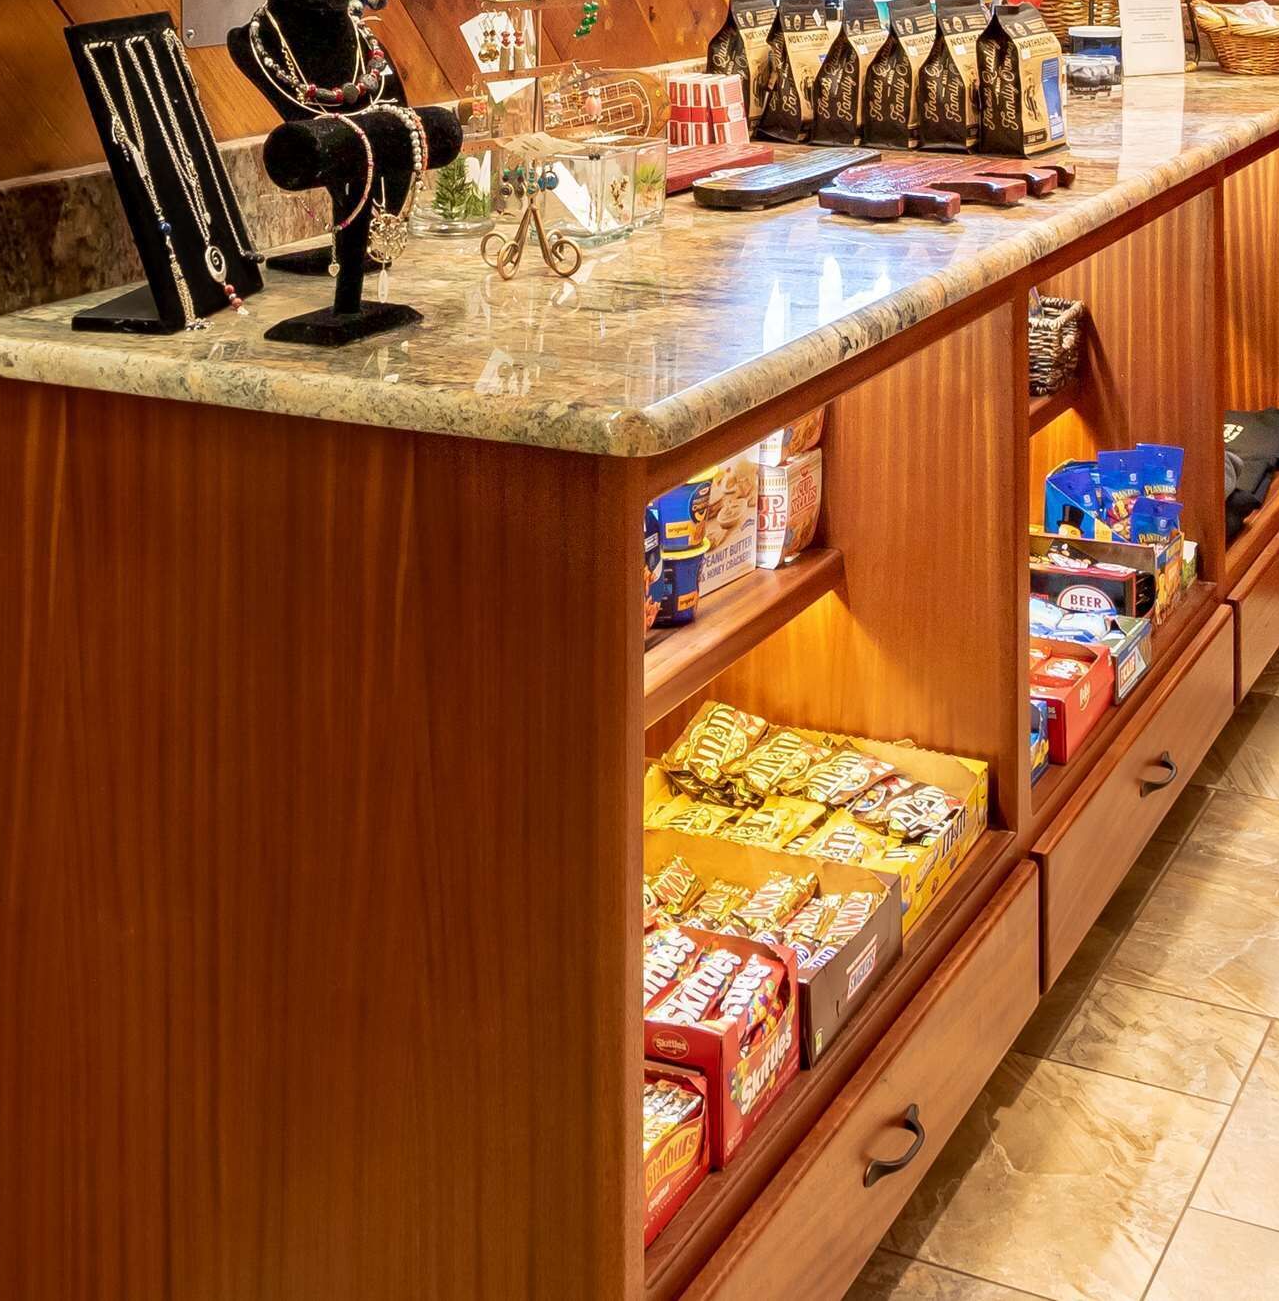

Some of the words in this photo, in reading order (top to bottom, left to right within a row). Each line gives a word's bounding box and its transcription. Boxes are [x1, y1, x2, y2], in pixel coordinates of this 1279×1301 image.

[818, 76, 833, 120] Finest
[837, 73, 857, 122] Family
[870, 78, 885, 122] Finest
[889, 73, 911, 124] Family
[924, 80, 940, 123] Finest
[945, 76, 963, 123] Family
[983, 85, 996, 131] Finest
[1000, 80, 1020, 131] Family
[1144, 482, 1177, 496] PLANTERS
[701, 546, 730, 573] PEANUT
[728, 534, 754, 559] BUTTER
[706, 563, 725, 582] HONEY
[1070, 593, 1103, 609] BEER
[667, 948, 742, 1027] Skittles
[655, 1037, 687, 1052] Skittles
[740, 1026, 792, 1116] Skittles
